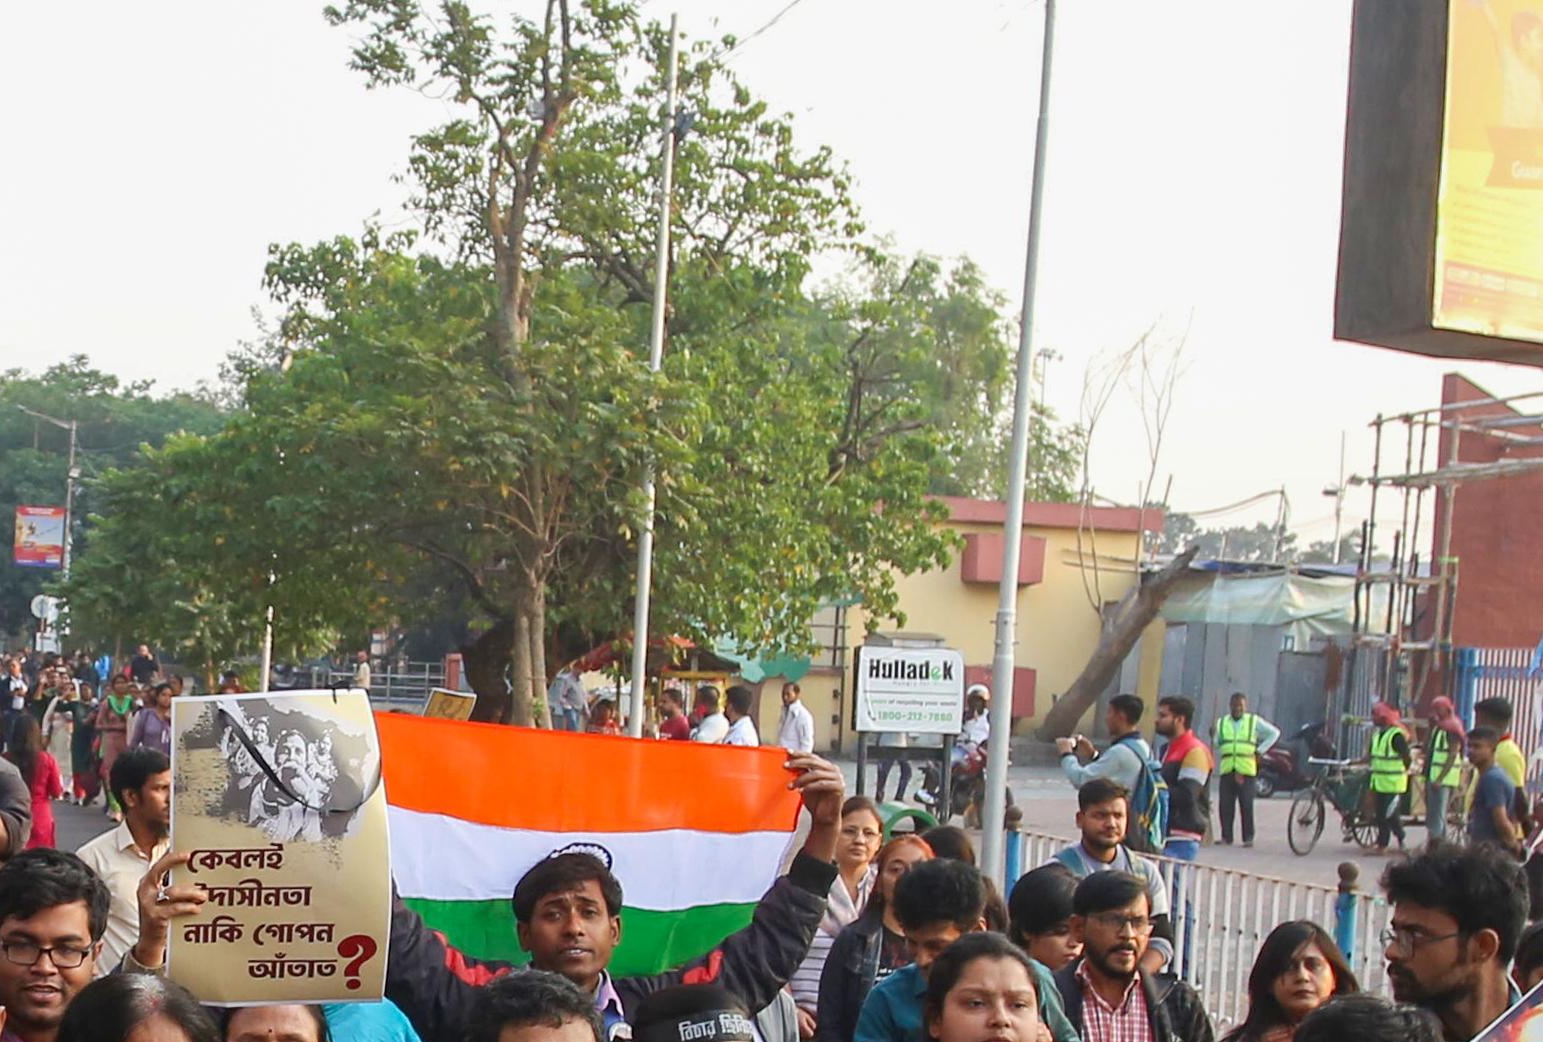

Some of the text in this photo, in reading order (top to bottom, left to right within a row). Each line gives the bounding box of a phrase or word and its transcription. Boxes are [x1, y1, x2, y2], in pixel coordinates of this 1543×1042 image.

[868, 658, 954, 681] Hulladek
[187, 843, 284, 874] কেবলই
[184, 915, 336, 946] নাকি গোপন
